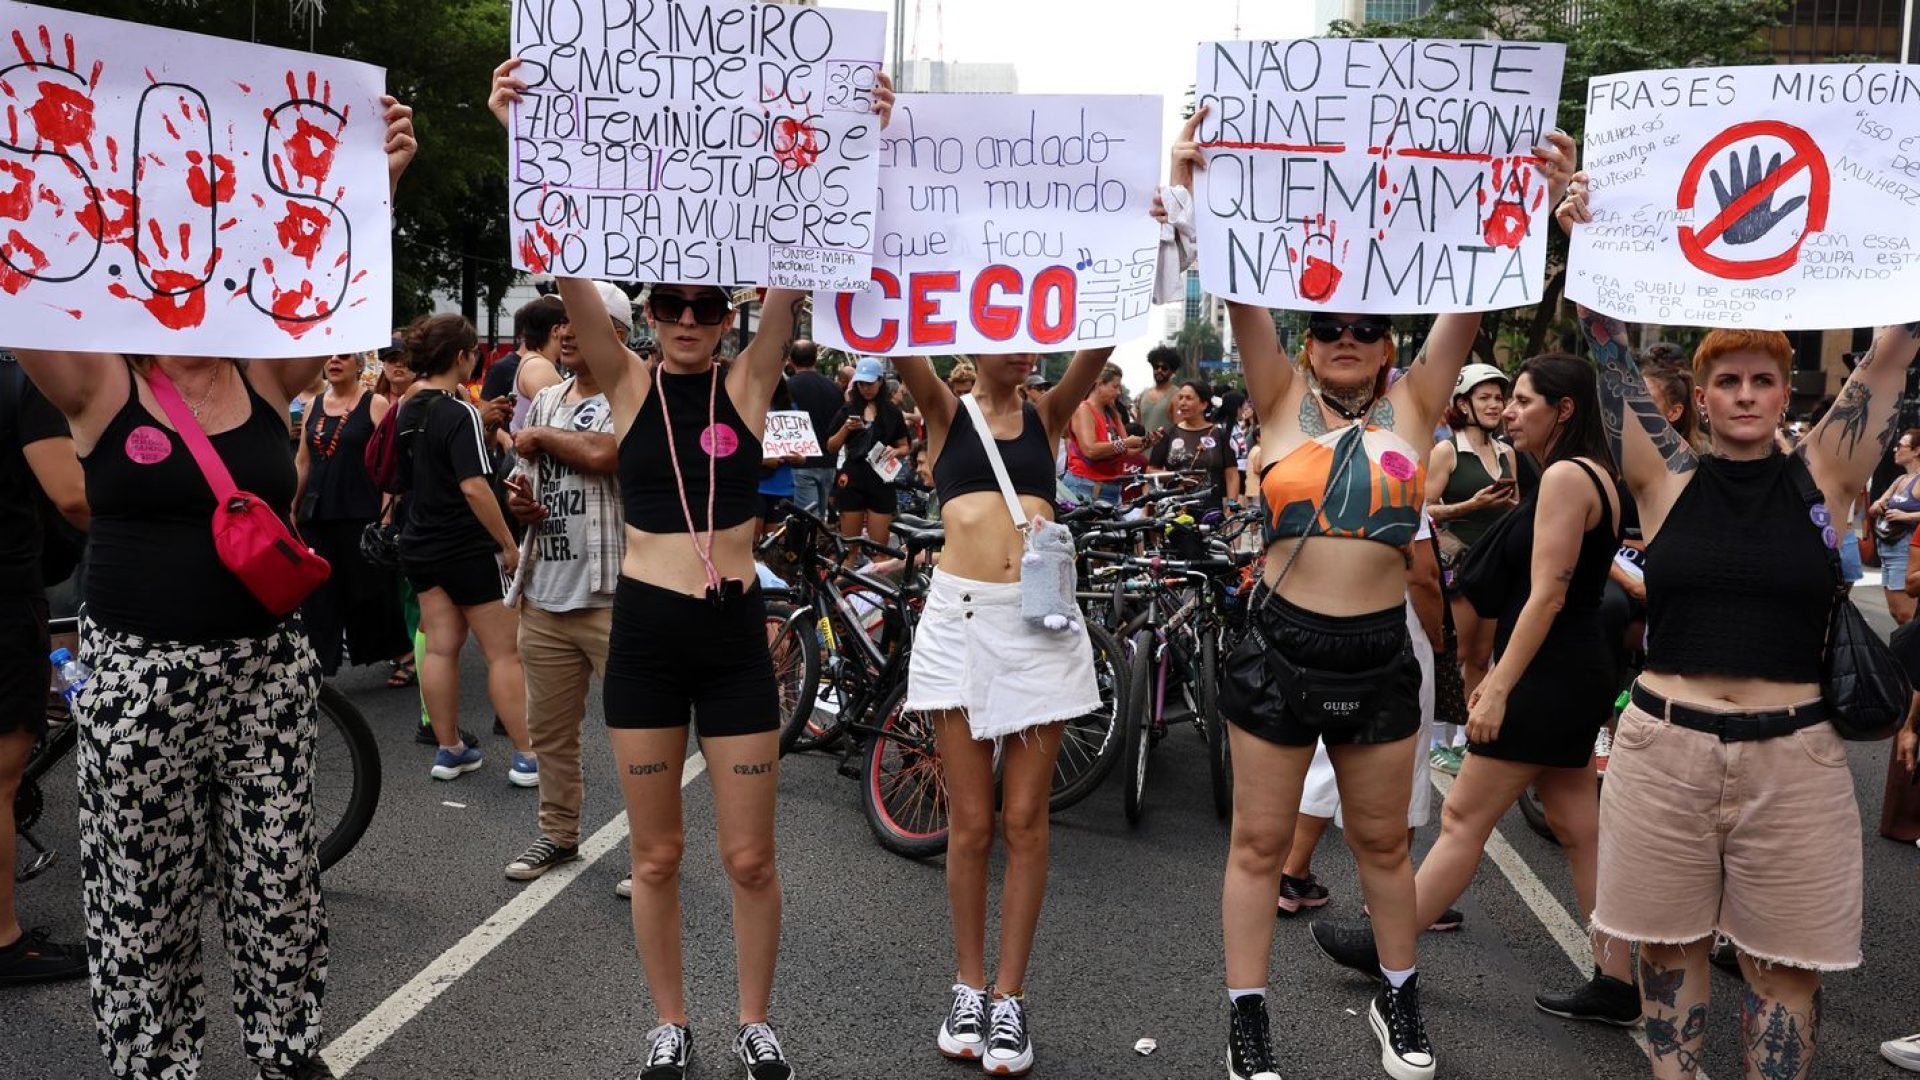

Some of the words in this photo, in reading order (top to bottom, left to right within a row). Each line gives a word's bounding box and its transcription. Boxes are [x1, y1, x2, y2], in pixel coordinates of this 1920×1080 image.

[1213, 38, 1322, 92] NÃO
[1345, 37, 1541, 95] EXISTE
[516, 91, 577, 138] 718
[1198, 93, 1347, 146] CRIME
[1588, 74, 1736, 115] FRASES
[879, 106, 964, 175] enho
[513, 186, 663, 236] CONTRA
[908, 184, 960, 214] um
[984, 165, 1127, 214] mundo
[1207, 153, 1377, 229] QUEM
[1388, 165, 1531, 237] AMA
[524, 228, 587, 275] NO
[883, 232, 948, 276] que
[981, 220, 1065, 264] ficou
[1227, 226, 1334, 299] NÃO
[1361, 236, 1529, 305] MATA
[835, 264, 1078, 353] CEGO
[1322, 701, 1361, 711] GUESS
